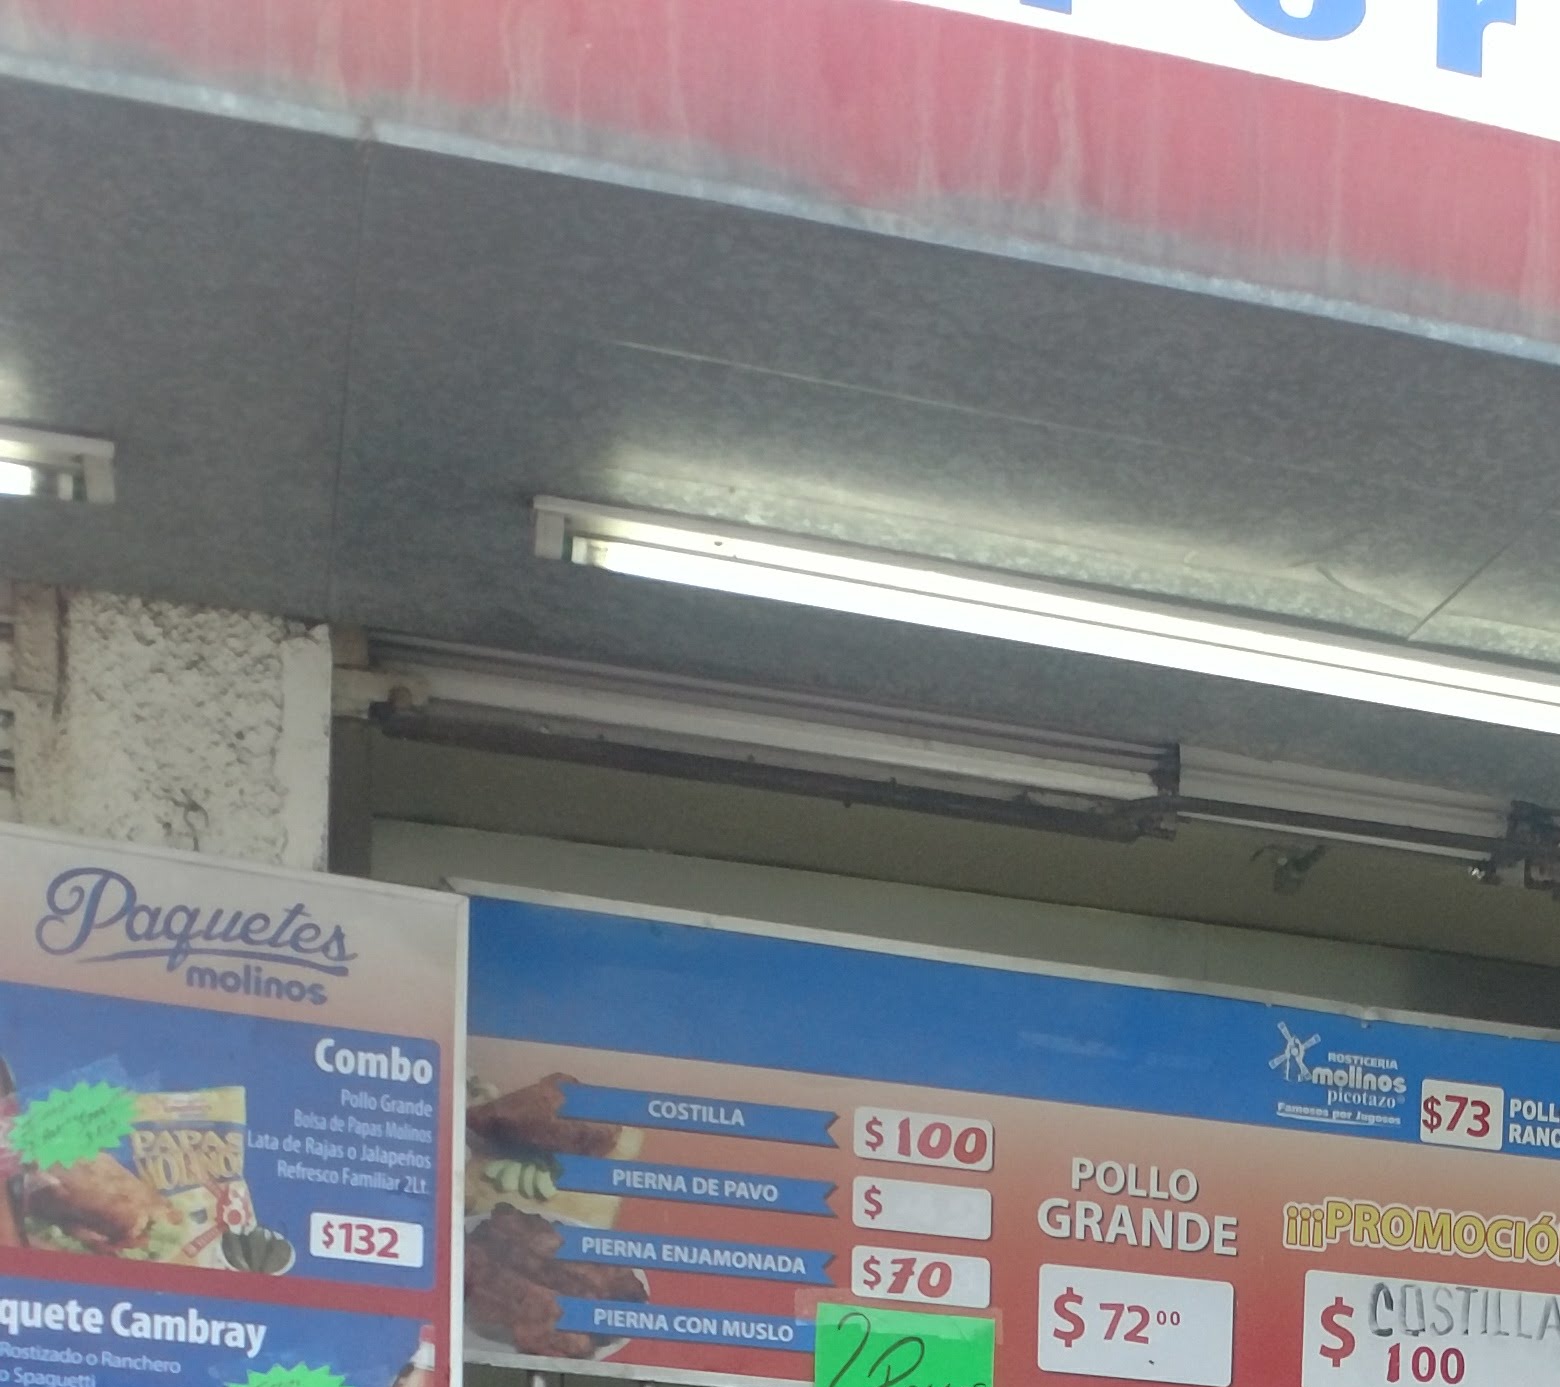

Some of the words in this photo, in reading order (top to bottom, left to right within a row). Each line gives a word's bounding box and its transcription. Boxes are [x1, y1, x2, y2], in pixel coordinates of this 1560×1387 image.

[36, 866, 359, 972] Paquetes
[185, 963, 328, 1006] molinos
[314, 1037, 434, 1085] Combo
[1311, 1065, 1407, 1094] molinos
[341, 1088, 378, 1111] Pollo
[380, 1093, 434, 1118] Grande
[648, 1100, 745, 1127] COSTILLA
[1327, 1086, 1396, 1109] picotazo
[293, 1108, 327, 1131] Bolsa
[347, 1115, 382, 1139] Papas
[1421, 1094, 1492, 1139] $73
[247, 1129, 279, 1150] Lata
[282, 1135, 302, 1154] de
[305, 1136, 345, 1161] Rajas
[346, 1145, 357, 1161] o
[277, 1159, 340, 1185] Refresco
[341, 1167, 401, 1191] Familiar
[612, 1168, 688, 1193] PIERNA
[692, 1177, 719, 1197] DE
[724, 1180, 779, 1203] PAVO
[1071, 1157, 1199, 1203] POLLO
[863, 1184, 883, 1220] $
[1037, 1197, 1239, 1257] GRANDE
[581, 1236, 657, 1261] PIERNA
[661, 1244, 807, 1275] ENJAMONADA
[110, 1301, 268, 1359] Cambray
[593, 1308, 669, 1332] PIERNA
[673, 1315, 718, 1336] CON
[722, 1319, 794, 1343] MUSLO
[85, 1353, 98, 1366] o
[101, 1350, 182, 1374] Ranchero
